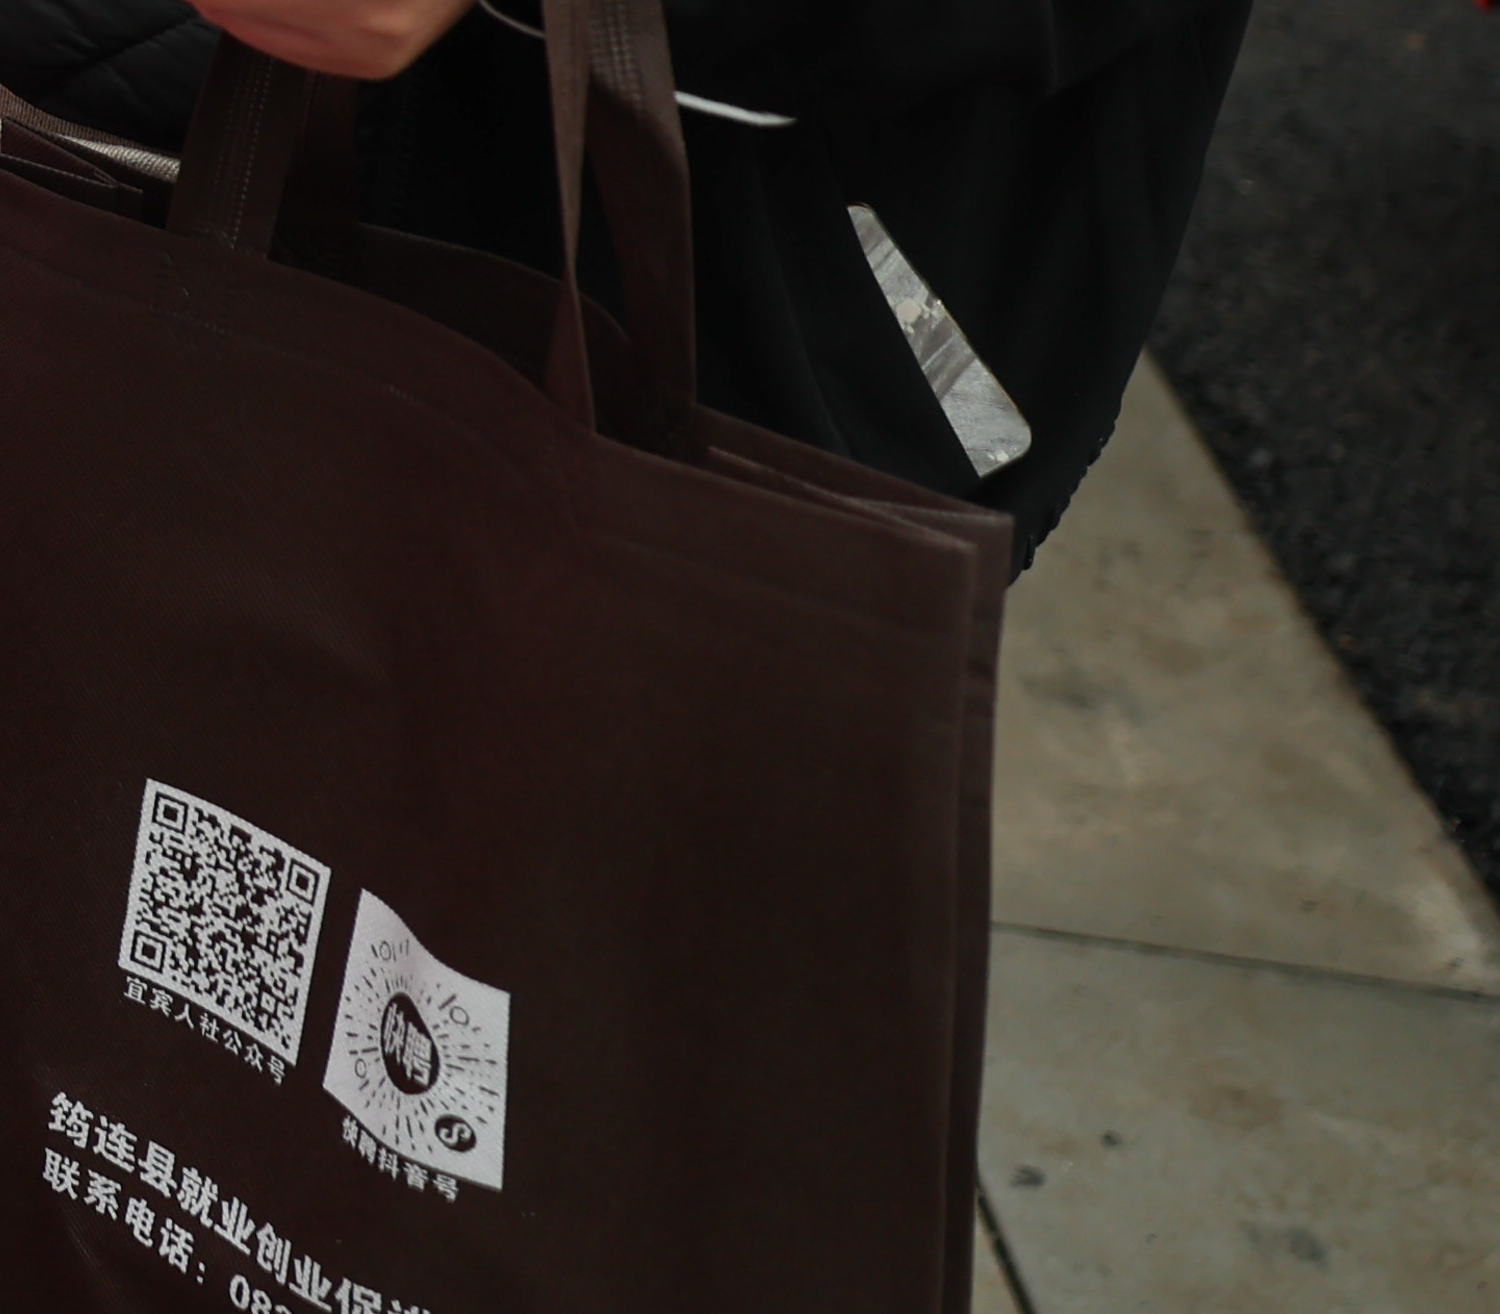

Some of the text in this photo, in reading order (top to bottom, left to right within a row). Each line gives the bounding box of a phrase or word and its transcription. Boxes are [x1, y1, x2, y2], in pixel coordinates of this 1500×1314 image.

[123, 975, 287, 1087] 宜宾人社公众号
[383, 1001, 433, 1088] 快聘
[48, 1091, 432, 1314] 筠连县就业创业保
[340, 1115, 461, 1203] 快聘抖音号
[42, 1147, 293, 1314] 联系电话：08
